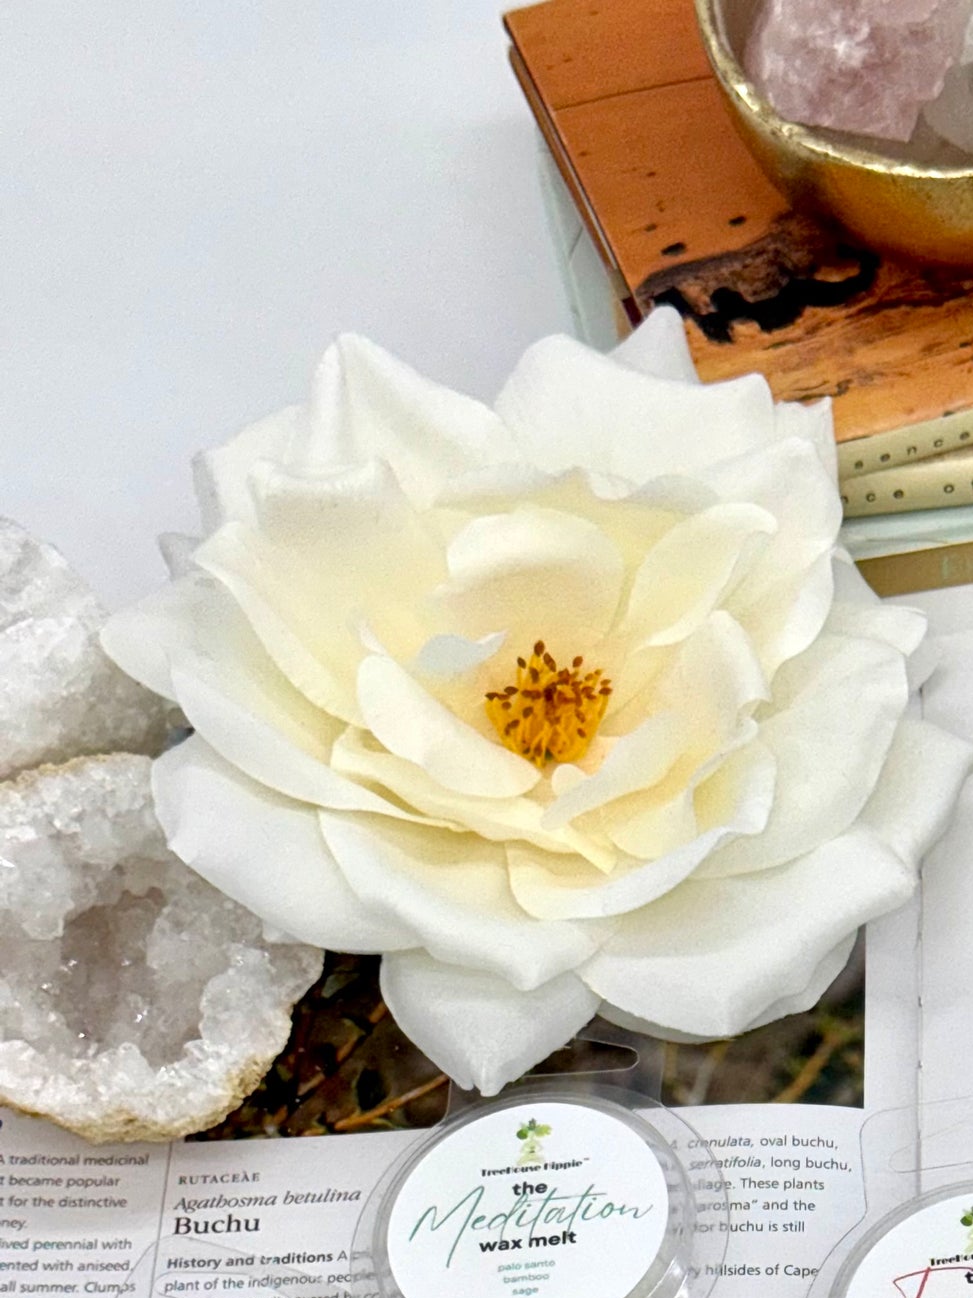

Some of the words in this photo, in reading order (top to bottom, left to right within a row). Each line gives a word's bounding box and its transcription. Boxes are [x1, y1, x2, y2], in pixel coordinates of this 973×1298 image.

[9, 1154, 79, 1166] traditional
[84, 1154, 149, 1166] medicinal
[282, 1188, 362, 1205] betulina
[512, 1181, 548, 1196] the
[173, 1214, 261, 1236] Buchu
[408, 1183, 654, 1269] Meditation
[478, 1238, 523, 1253] wax
[528, 1231, 577, 1248] melt
[167, 1257, 222, 1271] History
[225, 1255, 254, 1268] and
[260, 1251, 333, 1266] traditions
[497, 1261, 522, 1272] palo
[524, 1259, 556, 1269] santo
[503, 1272, 550, 1283] bamboo
[511, 1286, 539, 1296] sage
